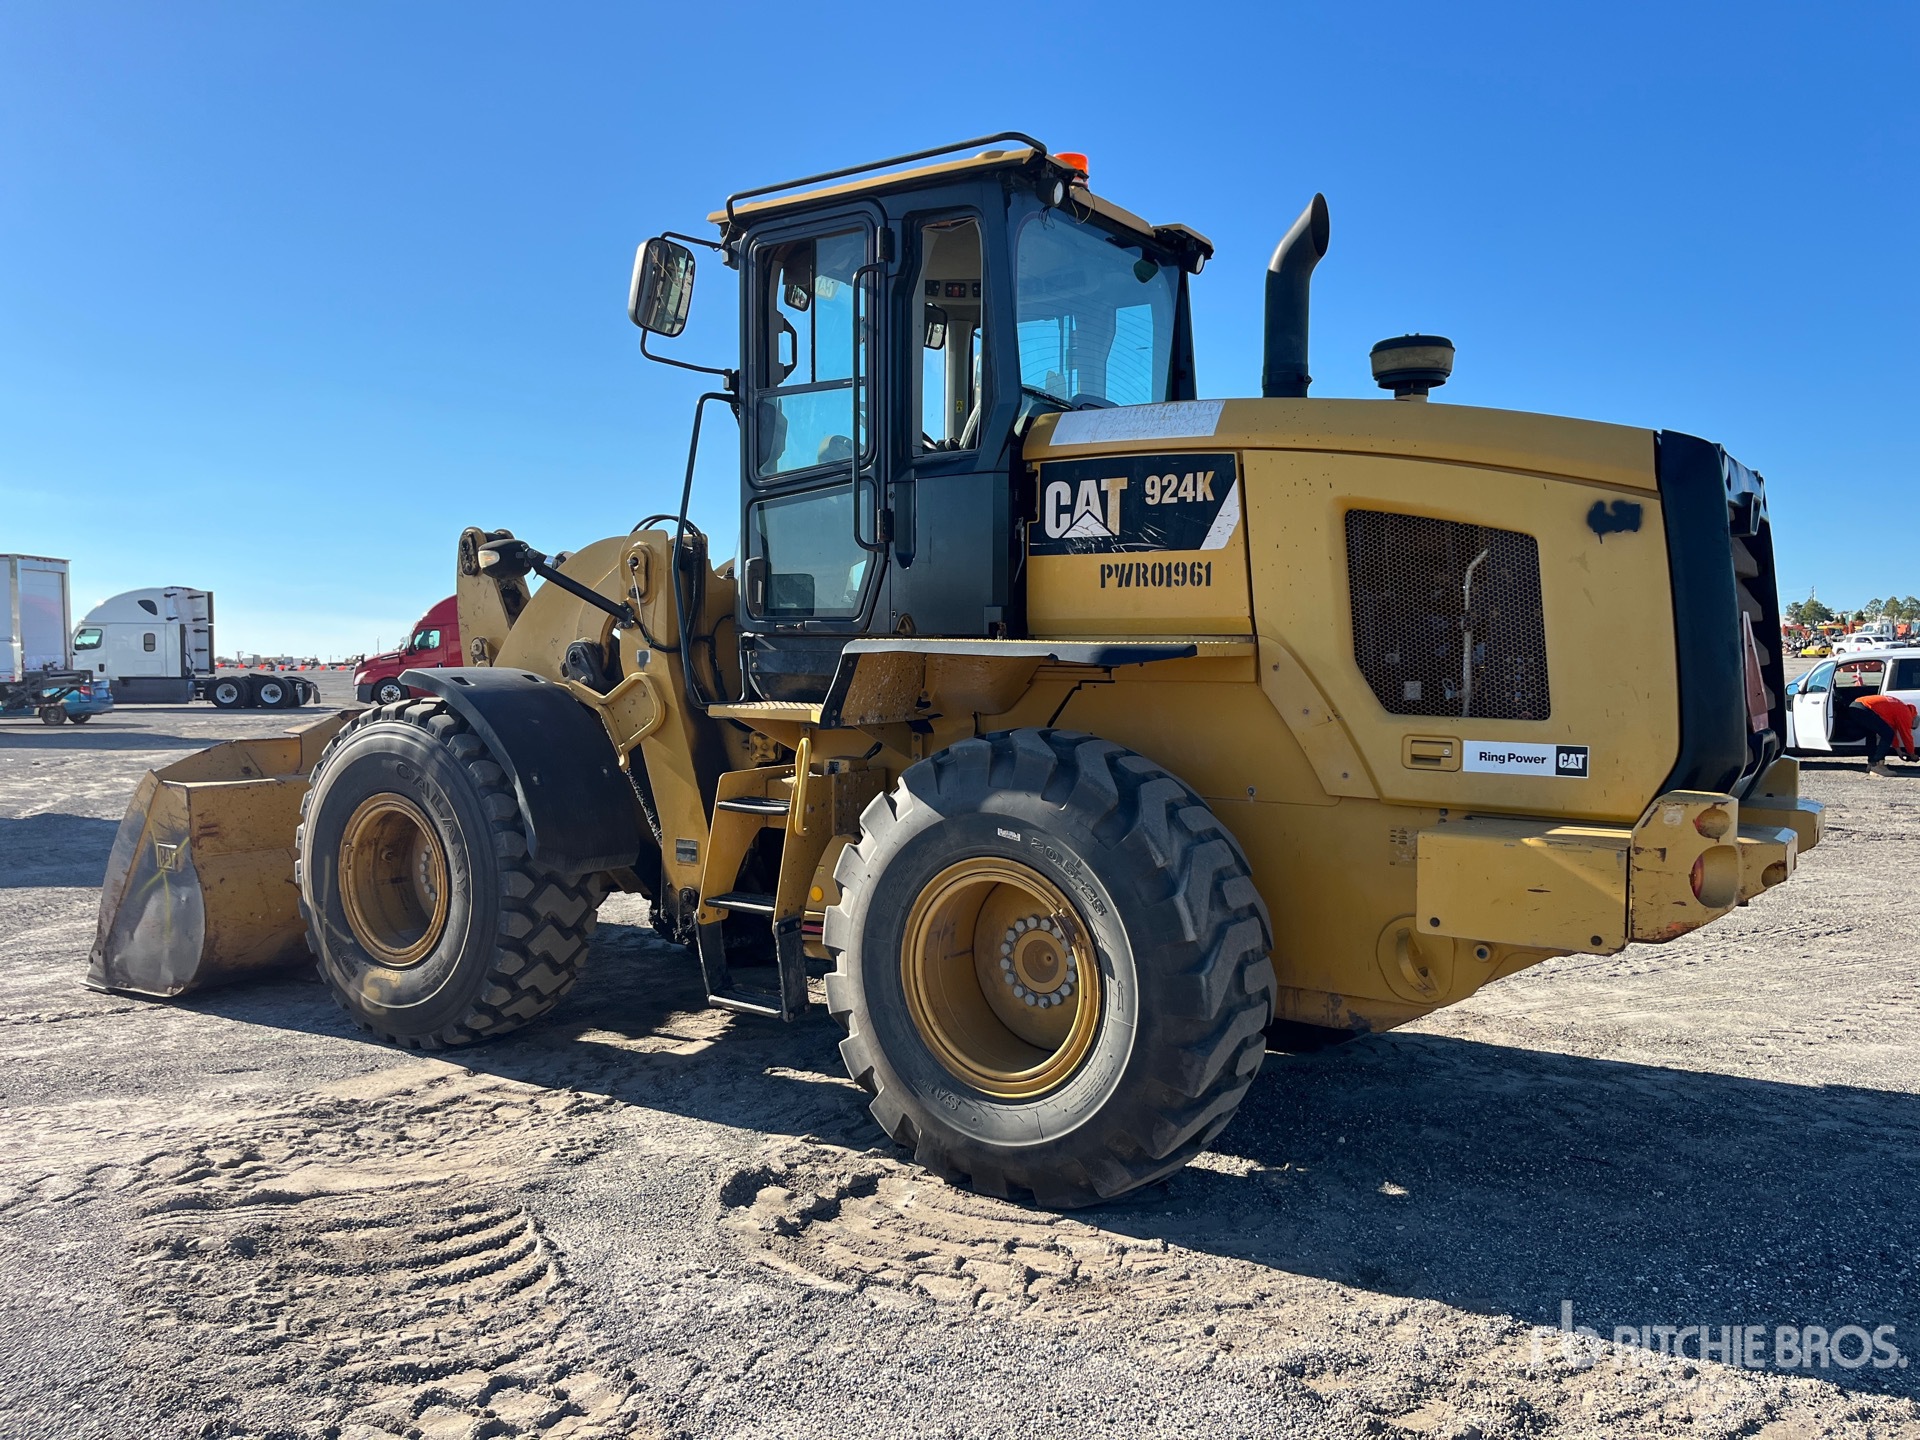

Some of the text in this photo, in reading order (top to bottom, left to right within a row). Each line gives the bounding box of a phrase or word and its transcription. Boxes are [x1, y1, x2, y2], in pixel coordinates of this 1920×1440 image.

[1145, 470, 1215, 505] 924K
[1045, 477, 1128, 539] CAT
[1101, 561, 1212, 588] PWR01961
[1479, 751, 1547, 765] Ring Power
[1558, 753, 1587, 769] CAT
